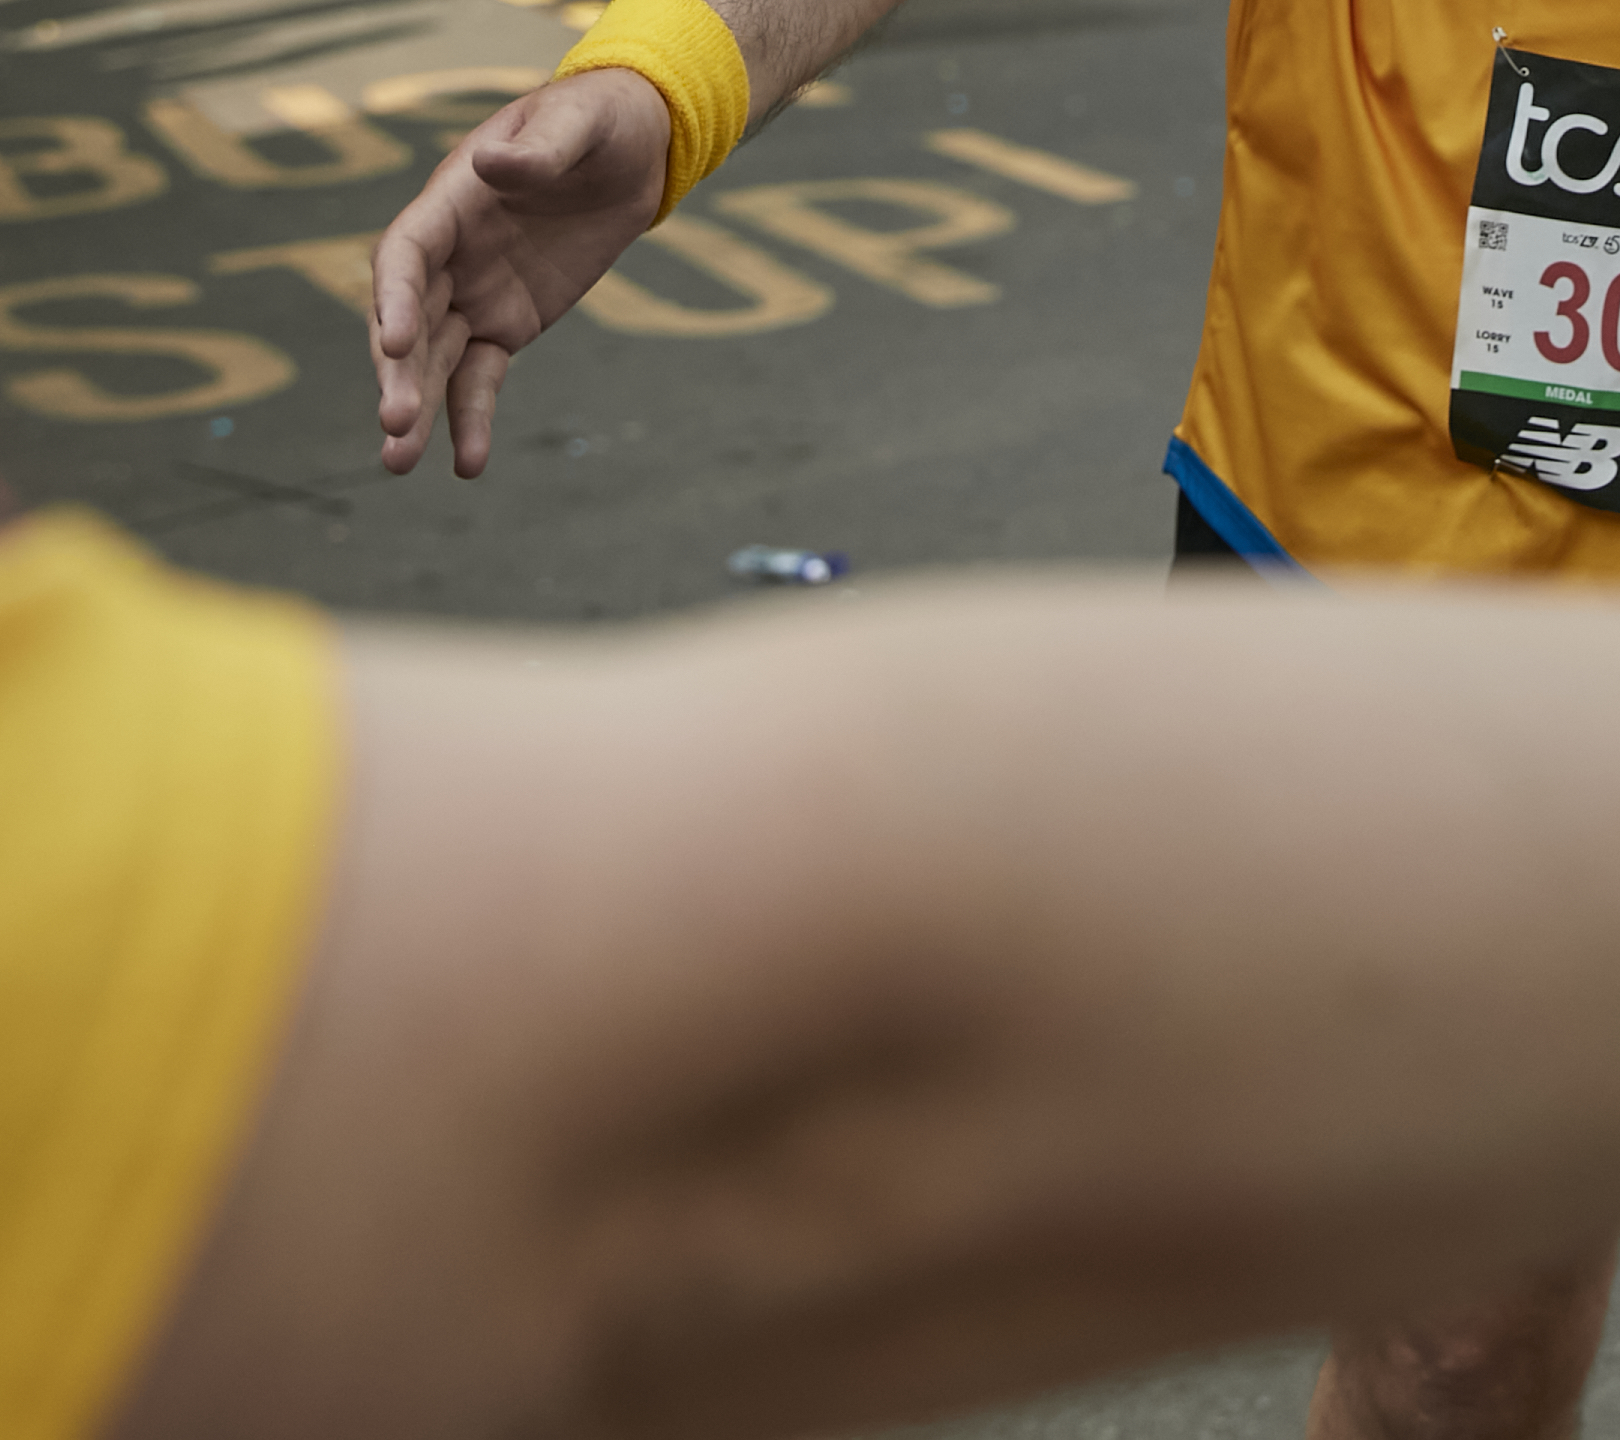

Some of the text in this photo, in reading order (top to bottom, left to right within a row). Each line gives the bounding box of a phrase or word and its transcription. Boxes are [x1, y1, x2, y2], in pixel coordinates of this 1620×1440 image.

[1482, 285, 1514, 300] WAVE
[1491, 299, 1504, 309] 15
[1476, 329, 1511, 344] LORRY
[1486, 343, 1499, 354] 15
[1545, 385, 1594, 405] MEDAL
